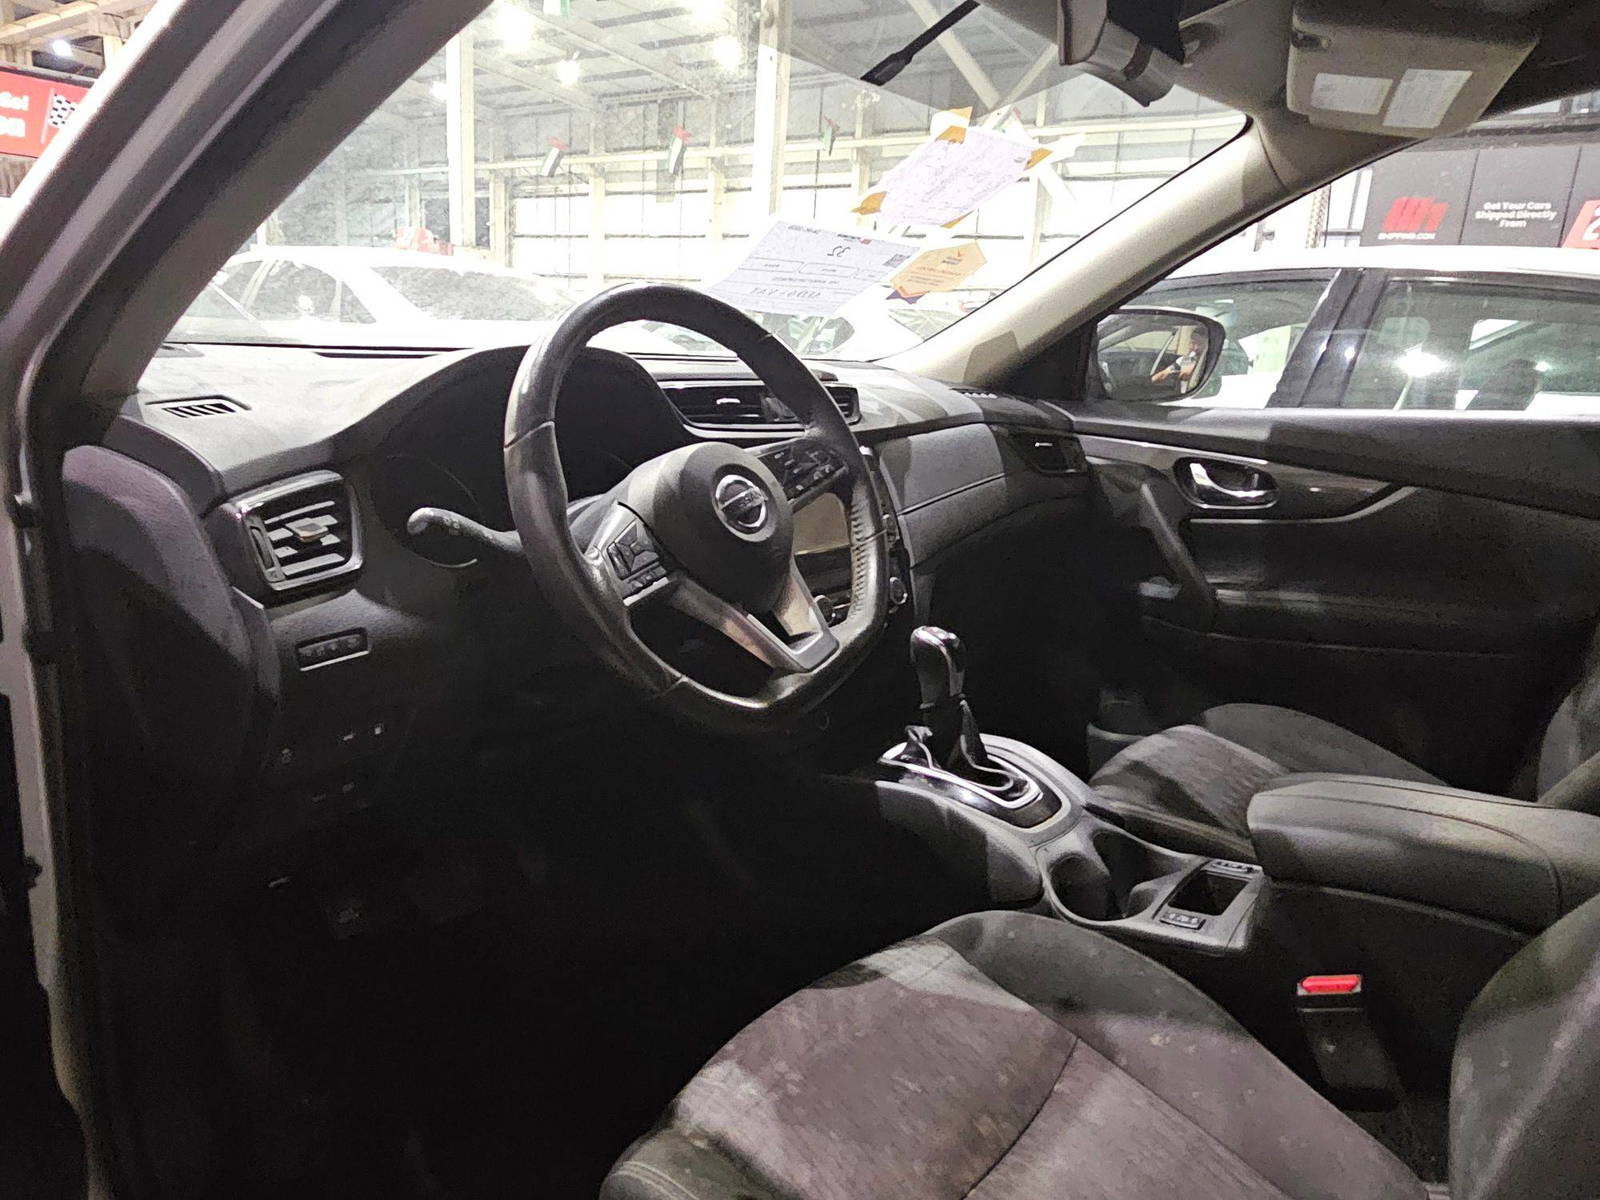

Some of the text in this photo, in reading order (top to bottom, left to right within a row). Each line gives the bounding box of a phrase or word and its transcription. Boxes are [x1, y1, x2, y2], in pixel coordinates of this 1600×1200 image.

[1483, 201, 1551, 210] Get Your Cars
[1475, 210, 1557, 221] Shipped Directly
[1499, 220, 1527, 228] From
